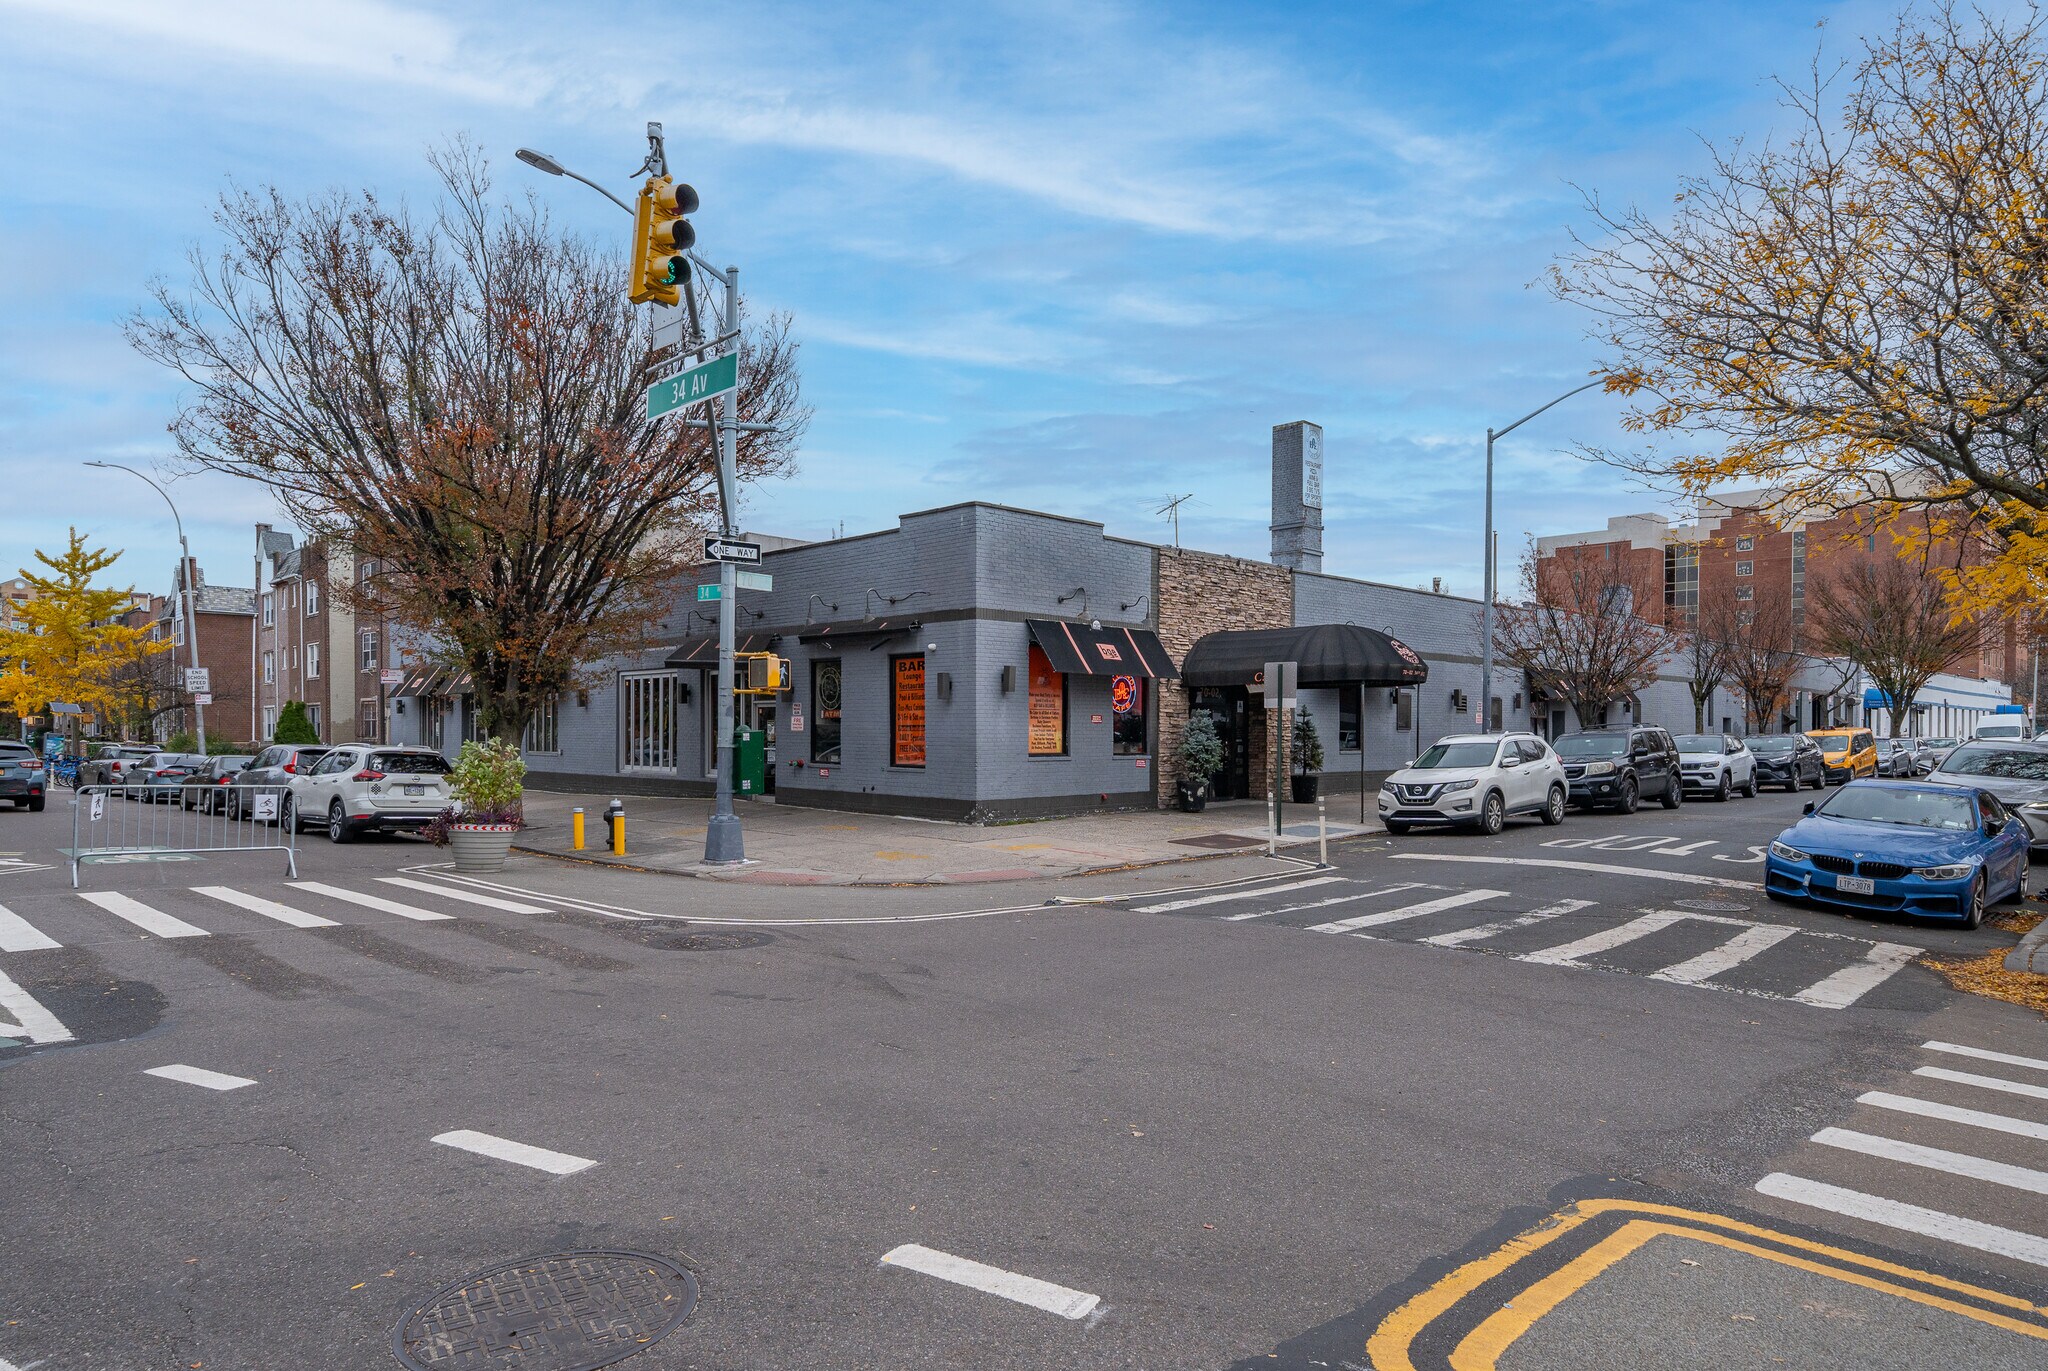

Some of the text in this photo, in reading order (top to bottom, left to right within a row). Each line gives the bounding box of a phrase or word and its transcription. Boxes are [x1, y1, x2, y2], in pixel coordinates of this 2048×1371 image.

[672, 373, 708, 404] 34 Av
[713, 545, 754, 558] ONE WAY
[700, 587, 709, 599] 34
[898, 660, 925, 673] BAR
[903, 673, 921, 681] Lounge
[824, 710, 840, 718] ATM
[1839, 879, 1871, 891] LTP-3078
